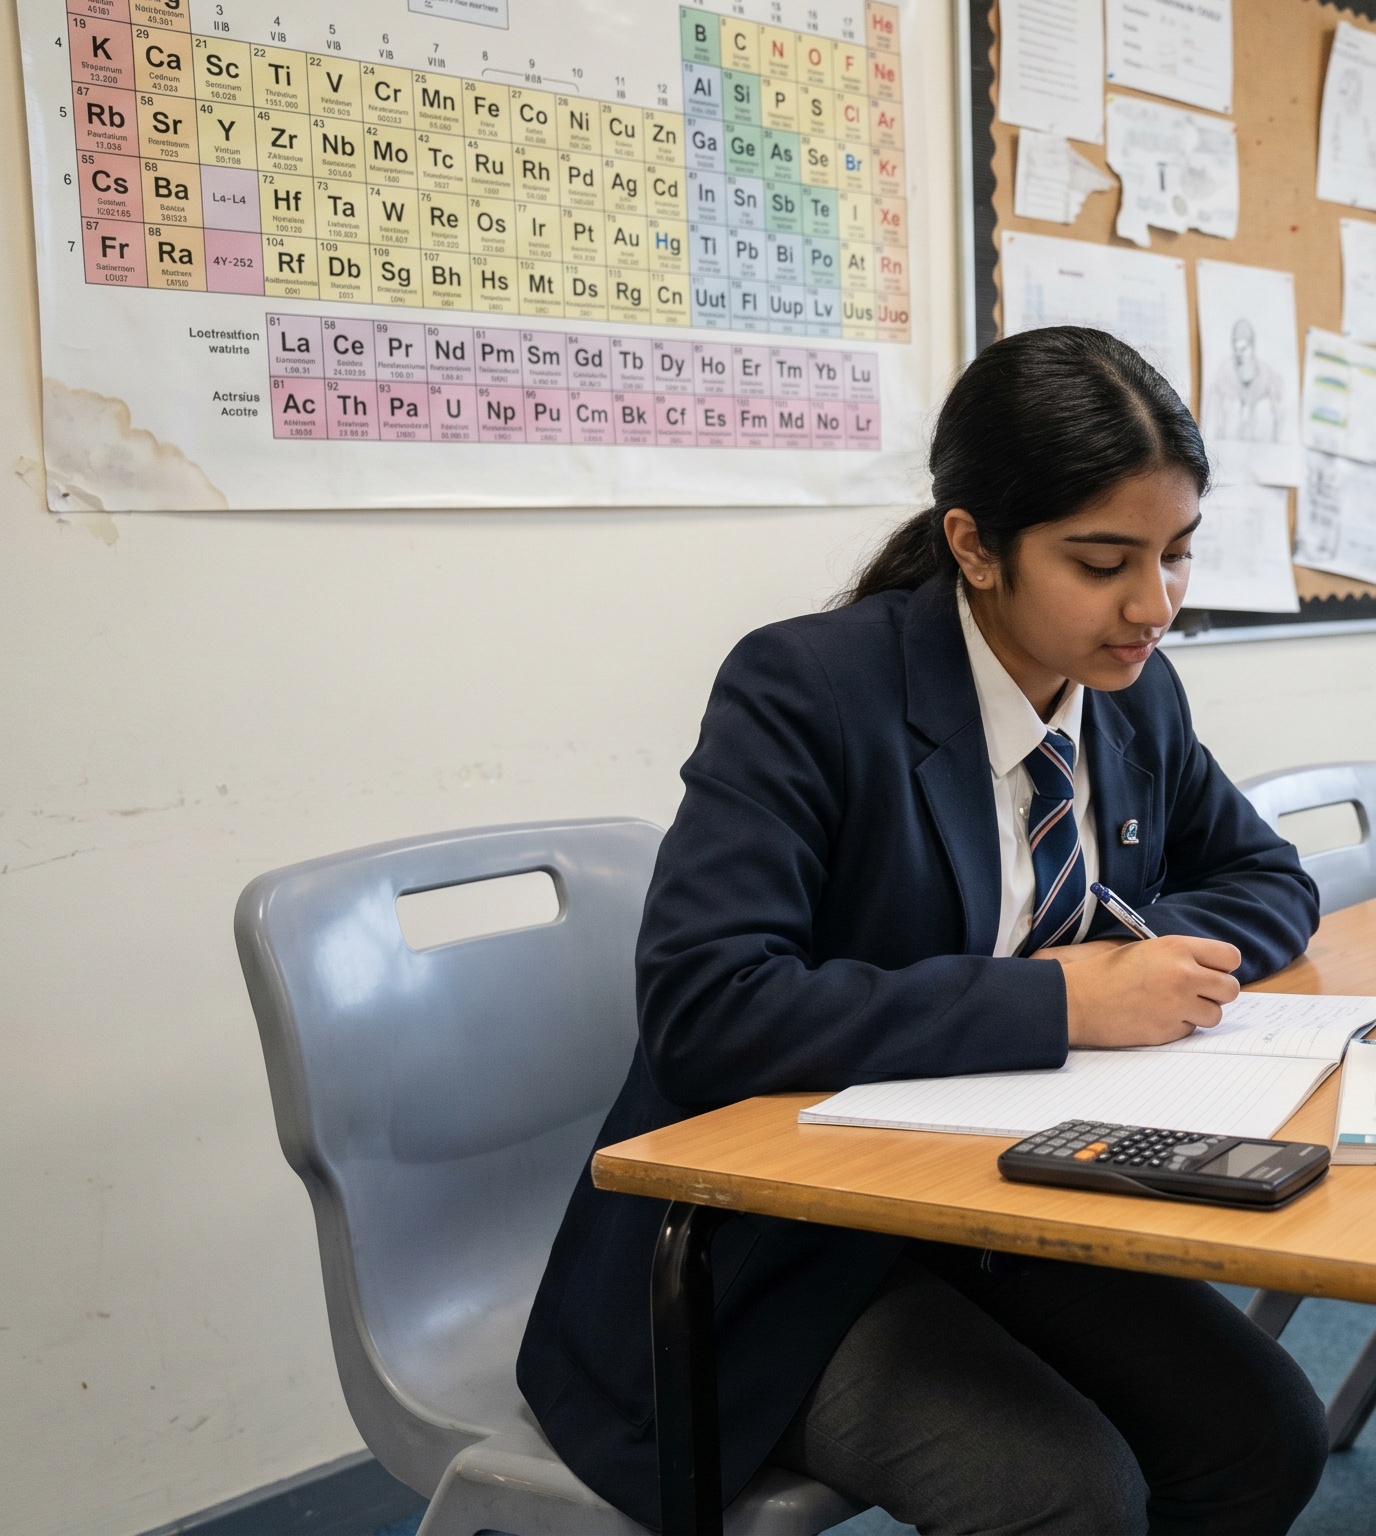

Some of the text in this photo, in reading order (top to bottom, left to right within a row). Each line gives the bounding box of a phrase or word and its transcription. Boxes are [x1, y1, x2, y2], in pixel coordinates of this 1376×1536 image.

[216, 4, 224, 16] 3
[274, 16, 281, 26] 4
[329, 24, 336, 34] 5
[872, 14, 893, 34] He
[55, 37, 62, 47] 4
[382, 34, 389, 44] 6
[695, 24, 707, 42] B
[734, 33, 747, 50] C
[92, 36, 112, 60] K
[195, 39, 208, 48] 21
[254, 48, 266, 57] 22
[433, 43, 439, 53] 7
[772, 41, 784, 58] N
[145, 45, 181, 71] Ca
[309, 57, 321, 66] 22
[482, 51, 488, 61] 8
[529, 59, 535, 68] 9
[809, 49, 822, 65] O
[845, 55, 854, 71] F
[206, 54, 240, 79] Sc
[268, 63, 291, 86] Ti
[363, 66, 375, 75] 24
[572, 69, 583, 78] 10
[874, 63, 895, 82] Ne
[326, 71, 343, 93] V
[415, 74, 427, 83] 25
[694, 77, 711, 97] Al
[374, 81, 402, 102] Cr
[421, 88, 455, 111] Mn
[512, 90, 522, 99] 27
[734, 84, 750, 104] Si
[775, 92, 786, 109] P
[60, 107, 67, 117] 5
[87, 103, 125, 128] Rb
[474, 96, 500, 117] Fe
[519, 104, 548, 125] Co
[811, 99, 822, 116] S
[152, 111, 182, 135] Sr
[217, 119, 236, 141] Y
[570, 111, 590, 131] Ni
[609, 118, 635, 138] Cu
[877, 112, 895, 129] Ar
[271, 127, 298, 149] Zr
[366, 127, 378, 136] 42
[653, 125, 676, 144] Zn
[692, 131, 717, 151] Ga
[322, 133, 354, 157] Nb
[373, 140, 408, 163] Mo
[731, 137, 755, 157] Ge
[770, 143, 793, 162] As
[428, 148, 454, 169] Tc
[475, 154, 504, 175] Ru
[808, 149, 829, 167] Se
[845, 154, 863, 172] Br
[522, 160, 550, 181] Rh
[568, 166, 594, 187] Pd
[879, 160, 897, 177] Kr
[64, 174, 72, 185] 6
[91, 170, 129, 194] Cs
[154, 176, 189, 200] Ba
[262, 175, 274, 185] 72
[317, 181, 328, 190] 73
[612, 173, 637, 197] Ag
[653, 178, 678, 197] Cd
[274, 189, 301, 211] Hf
[369, 188, 381, 196] 74
[699, 184, 715, 203] In
[734, 188, 757, 208] Sn
[328, 195, 355, 218] Ta
[382, 201, 405, 222] W
[772, 195, 795, 213] Sb
[811, 199, 830, 217] Te
[430, 206, 459, 228] Re
[477, 212, 506, 233] Os
[881, 208, 900, 226] Xe
[532, 218, 546, 237] Ir
[574, 223, 594, 243] Pt
[68, 241, 75, 252] 7
[266, 237, 284, 247] 104
[614, 228, 640, 247] Au
[656, 232, 681, 256] Hg
[101, 236, 129, 259] Fr
[158, 241, 193, 265] Ra
[424, 252, 439, 261] 107
[736, 241, 759, 260] Pb
[777, 245, 793, 263] Bi
[278, 252, 305, 274] Rf
[328, 256, 361, 278] Db
[811, 250, 833, 267] Po
[849, 254, 865, 270] At
[881, 257, 902, 275] Rn
[381, 261, 411, 287] Sg
[432, 266, 461, 286] Bh
[481, 270, 509, 290] Hs
[529, 274, 554, 294] Mt
[572, 278, 598, 298] Ds
[616, 282, 642, 306] Rg
[657, 287, 683, 305] Cn
[696, 290, 726, 308] Uut
[770, 296, 803, 318] Uup
[814, 300, 833, 317] Lv
[843, 303, 873, 320] Uus
[280, 331, 310, 354] La
[333, 334, 364, 356] Ce
[388, 338, 414, 358] Pr
[434, 340, 466, 360] Nd
[481, 343, 514, 363] Pm
[528, 346, 560, 366] Sm
[575, 349, 603, 367] Gd
[619, 352, 643, 370] Tb
[661, 354, 685, 377] Dy
[701, 356, 725, 375] Ho
[743, 359, 761, 377] Er
[777, 361, 802, 379] Tm
[815, 363, 837, 380] Yb
[852, 365, 871, 383] Lu
[327, 382, 339, 391] 92
[282, 394, 316, 414] Ac
[338, 395, 367, 416] Th
[390, 398, 418, 418] Pa
[446, 400, 462, 418] U
[487, 401, 516, 425] Np
[535, 403, 561, 421] Pu
[576, 404, 608, 423] Cm
[622, 406, 647, 424] Bk
[666, 408, 686, 425] Cf
[704, 409, 727, 427] Es
[741, 411, 767, 428] Fm
[779, 412, 805, 429] Md
[817, 414, 839, 430] No
[856, 415, 872, 432] Lr
